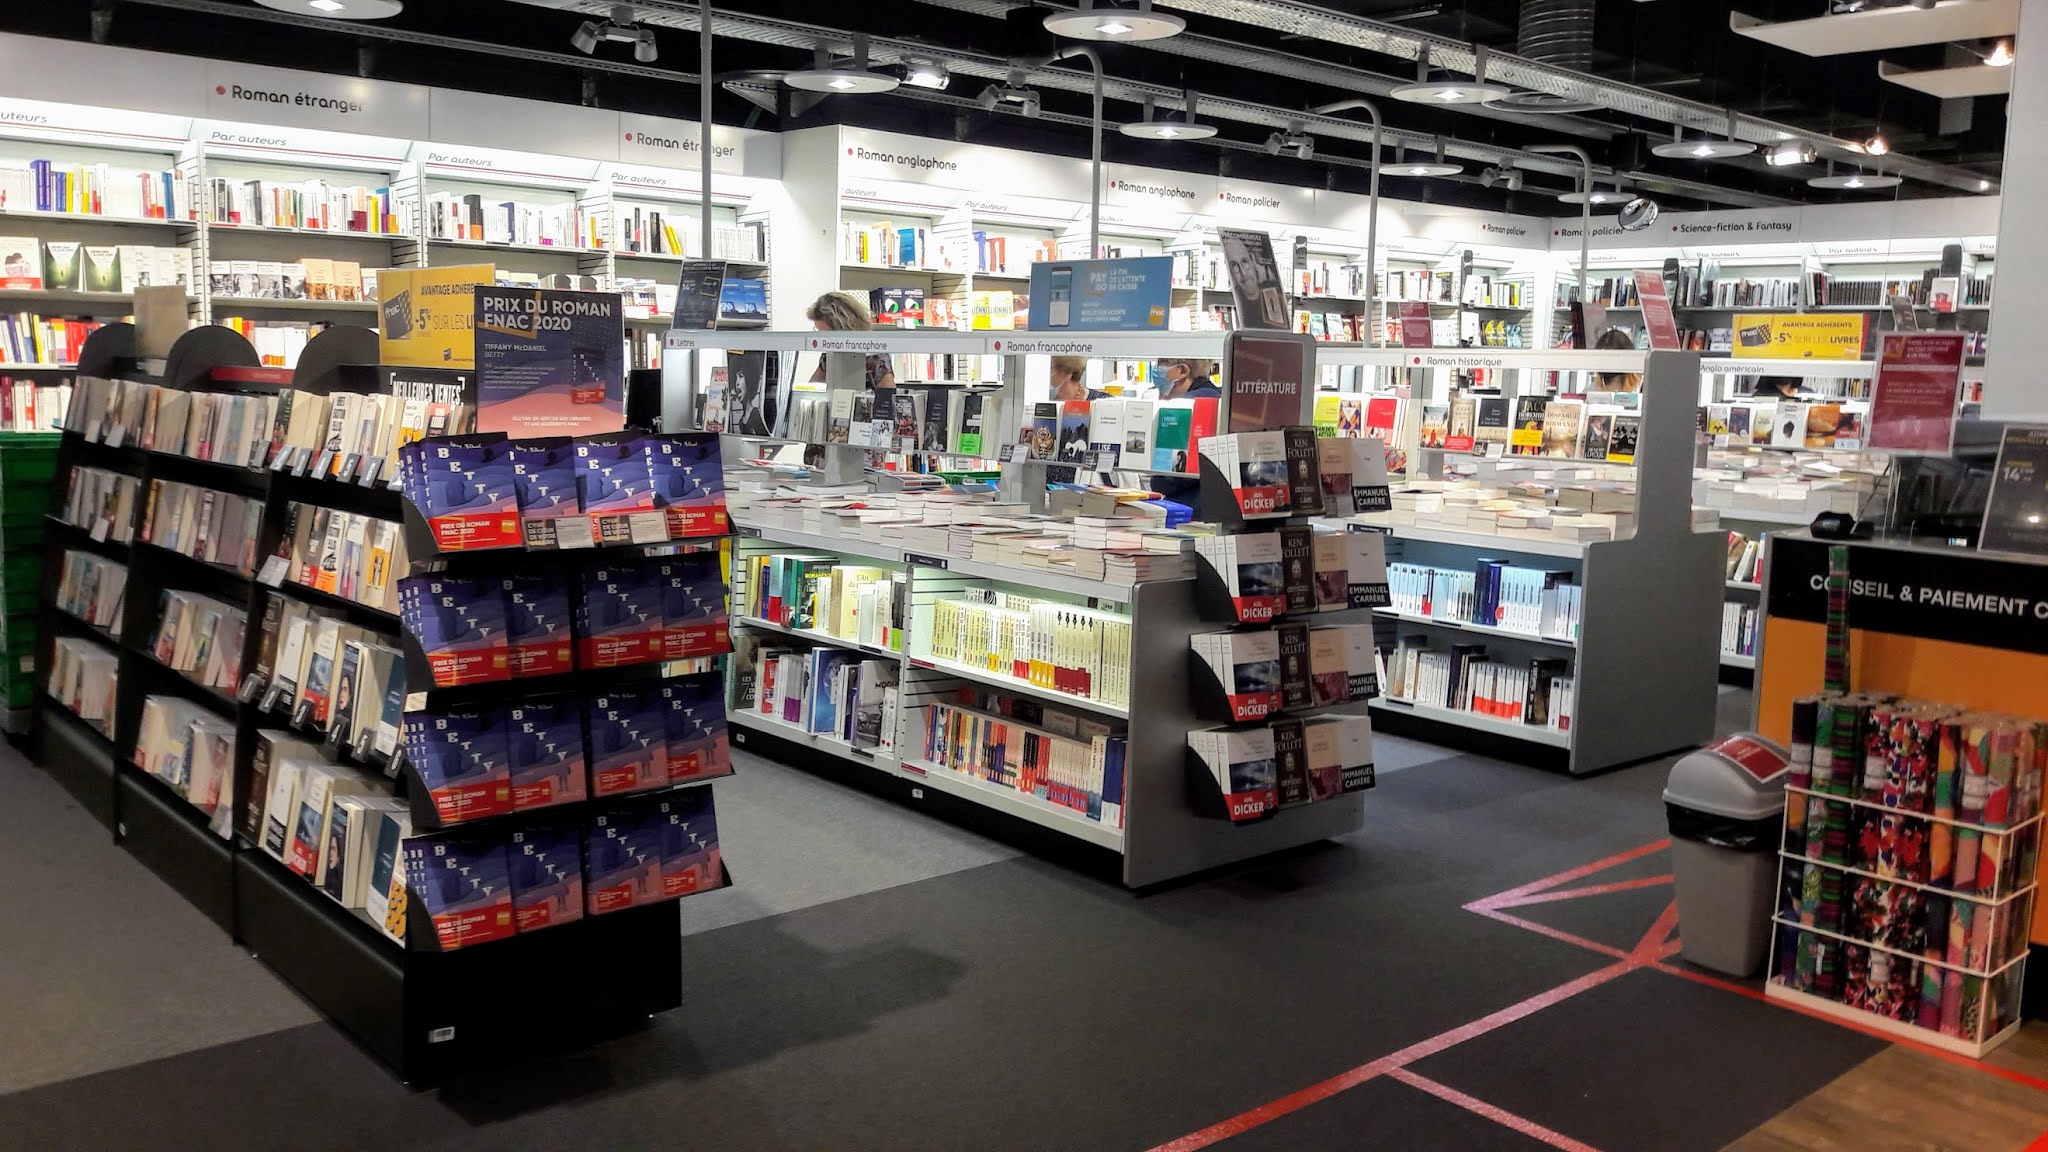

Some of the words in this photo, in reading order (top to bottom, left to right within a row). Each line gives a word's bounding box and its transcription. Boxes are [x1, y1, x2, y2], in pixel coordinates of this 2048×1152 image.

[232, 85, 290, 105] Roman
[295, 92, 364, 113] étranger
[0, 112, 48, 125] uteurs
[211, 131, 235, 143] Par
[239, 134, 287, 147] auteurs
[637, 132, 679, 150] Roman
[683, 138, 735, 157] étrnger
[428, 153, 447, 163] Par
[450, 156, 493, 167] auteurs
[857, 148, 894, 164] Roman
[897, 153, 957, 172] anglophone
[611, 172, 626, 182] Par
[629, 174, 667, 185] auteurs
[845, 187, 877, 197] auteurs
[1118, 181, 1146, 194] Roman
[1148, 184, 1196, 200] anglophone
[980, 203, 1008, 211] auteurs
[1226, 193, 1251, 207] Roman
[1253, 196, 1280, 209] policier
[1487, 223, 1503, 235] Roman
[1506, 225, 1526, 236] policier
[1592, 227, 1624, 238] policier
[1680, 223, 1744, 233] Science-fiction
[1747, 222, 1753, 230] &
[1756, 221, 1791, 232] Fantasy
[1090, 272, 1107, 284] PAY
[421, 285, 450, 296] AVANTAGE
[483, 296, 521, 314] PRIX
[525, 300, 549, 315] DU
[552, 300, 611, 317] ROMAN
[433, 315, 448, 330] SUR
[451, 315, 465, 330] LES
[484, 313, 529, 329] FNAC
[533, 316, 571, 331] 2020
[485, 343, 512, 351] TIFFANY
[513, 344, 547, 352] McDANIEL
[677, 339, 695, 348] Lettres
[822, 340, 844, 350] Roman
[846, 340, 888, 352] francophone
[1008, 341, 1037, 352] Roman
[1040, 341, 1092, 354] francophone
[1427, 356, 1456, 366] Roman
[1459, 356, 1502, 369] historique
[1700, 365, 1722, 375] Anglo
[1724, 364, 1764, 373] américain
[392, 381, 434, 402] MEILLEURES
[435, 384, 462, 405] VENTES
[1236, 379, 1296, 395] LITTÉRATURE
[1294, 438, 1308, 447] KEN
[1287, 448, 1315, 458] FOLLETT
[1354, 487, 1388, 497] EMMANUEL
[1244, 498, 1275, 510] DICKER
[1358, 495, 1386, 507] CARRÈRE
[468, 520, 490, 528] ROMAN
[1288, 538, 1303, 547] KEN
[1350, 585, 1388, 595] EMMANUEL
[1810, 574, 1894, 600] CSEIL
[1899, 585, 1913, 601] &
[1919, 587, 2030, 617] PAIEMENT
[1243, 607, 1273, 619] DICKER
[1284, 635, 1299, 644] KEN
[1281, 643, 1306, 655] OLLETT
[459, 656, 482, 665] ROMAN
[1350, 675, 1377, 686] MMANUEL
[1238, 704, 1268, 716] DICKER
[1281, 732, 1295, 742] KEN
[1342, 768, 1373, 781] EMMANUEL
[1234, 802, 1264, 816] DICKER
